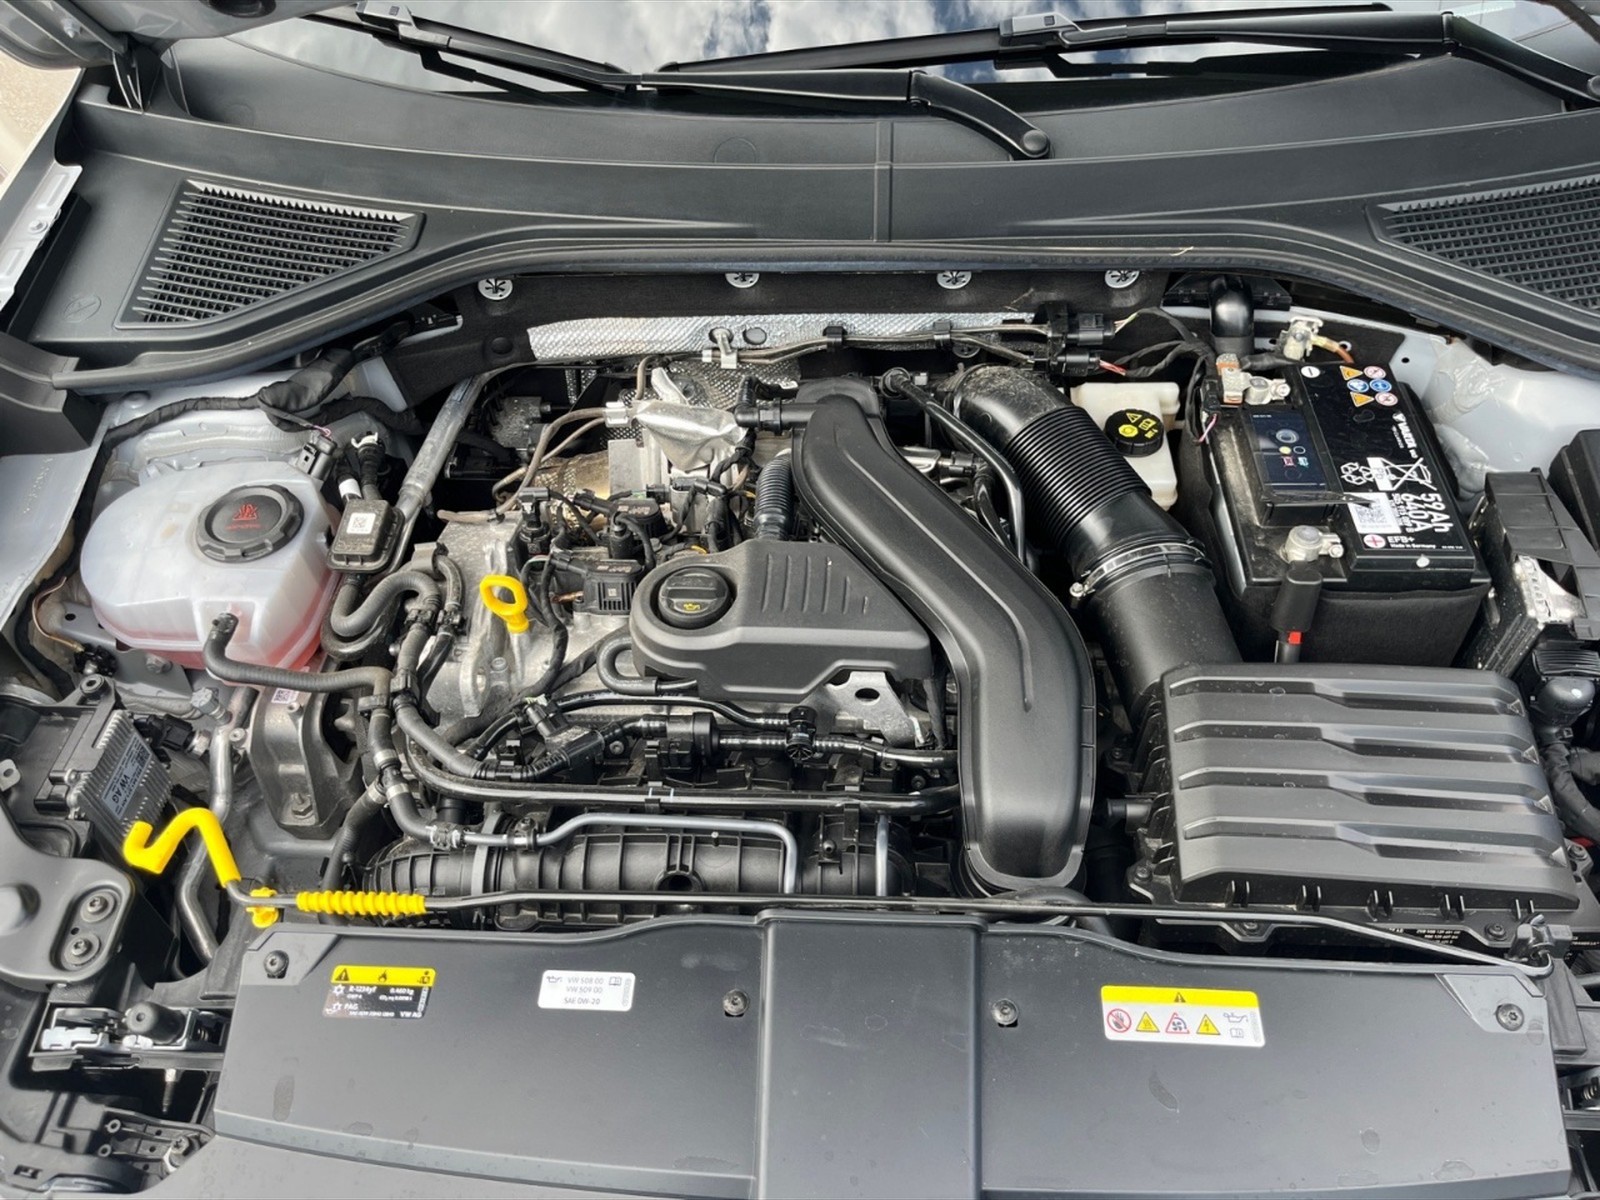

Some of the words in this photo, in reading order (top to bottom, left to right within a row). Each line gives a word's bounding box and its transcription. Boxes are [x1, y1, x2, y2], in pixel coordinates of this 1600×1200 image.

[1401, 493, 1433, 533] 640A
[1420, 493, 1453, 533] 59Ah
[119, 775, 130, 788] VW
[112, 789, 122, 804] AG
[567, 976, 580, 984] VW
